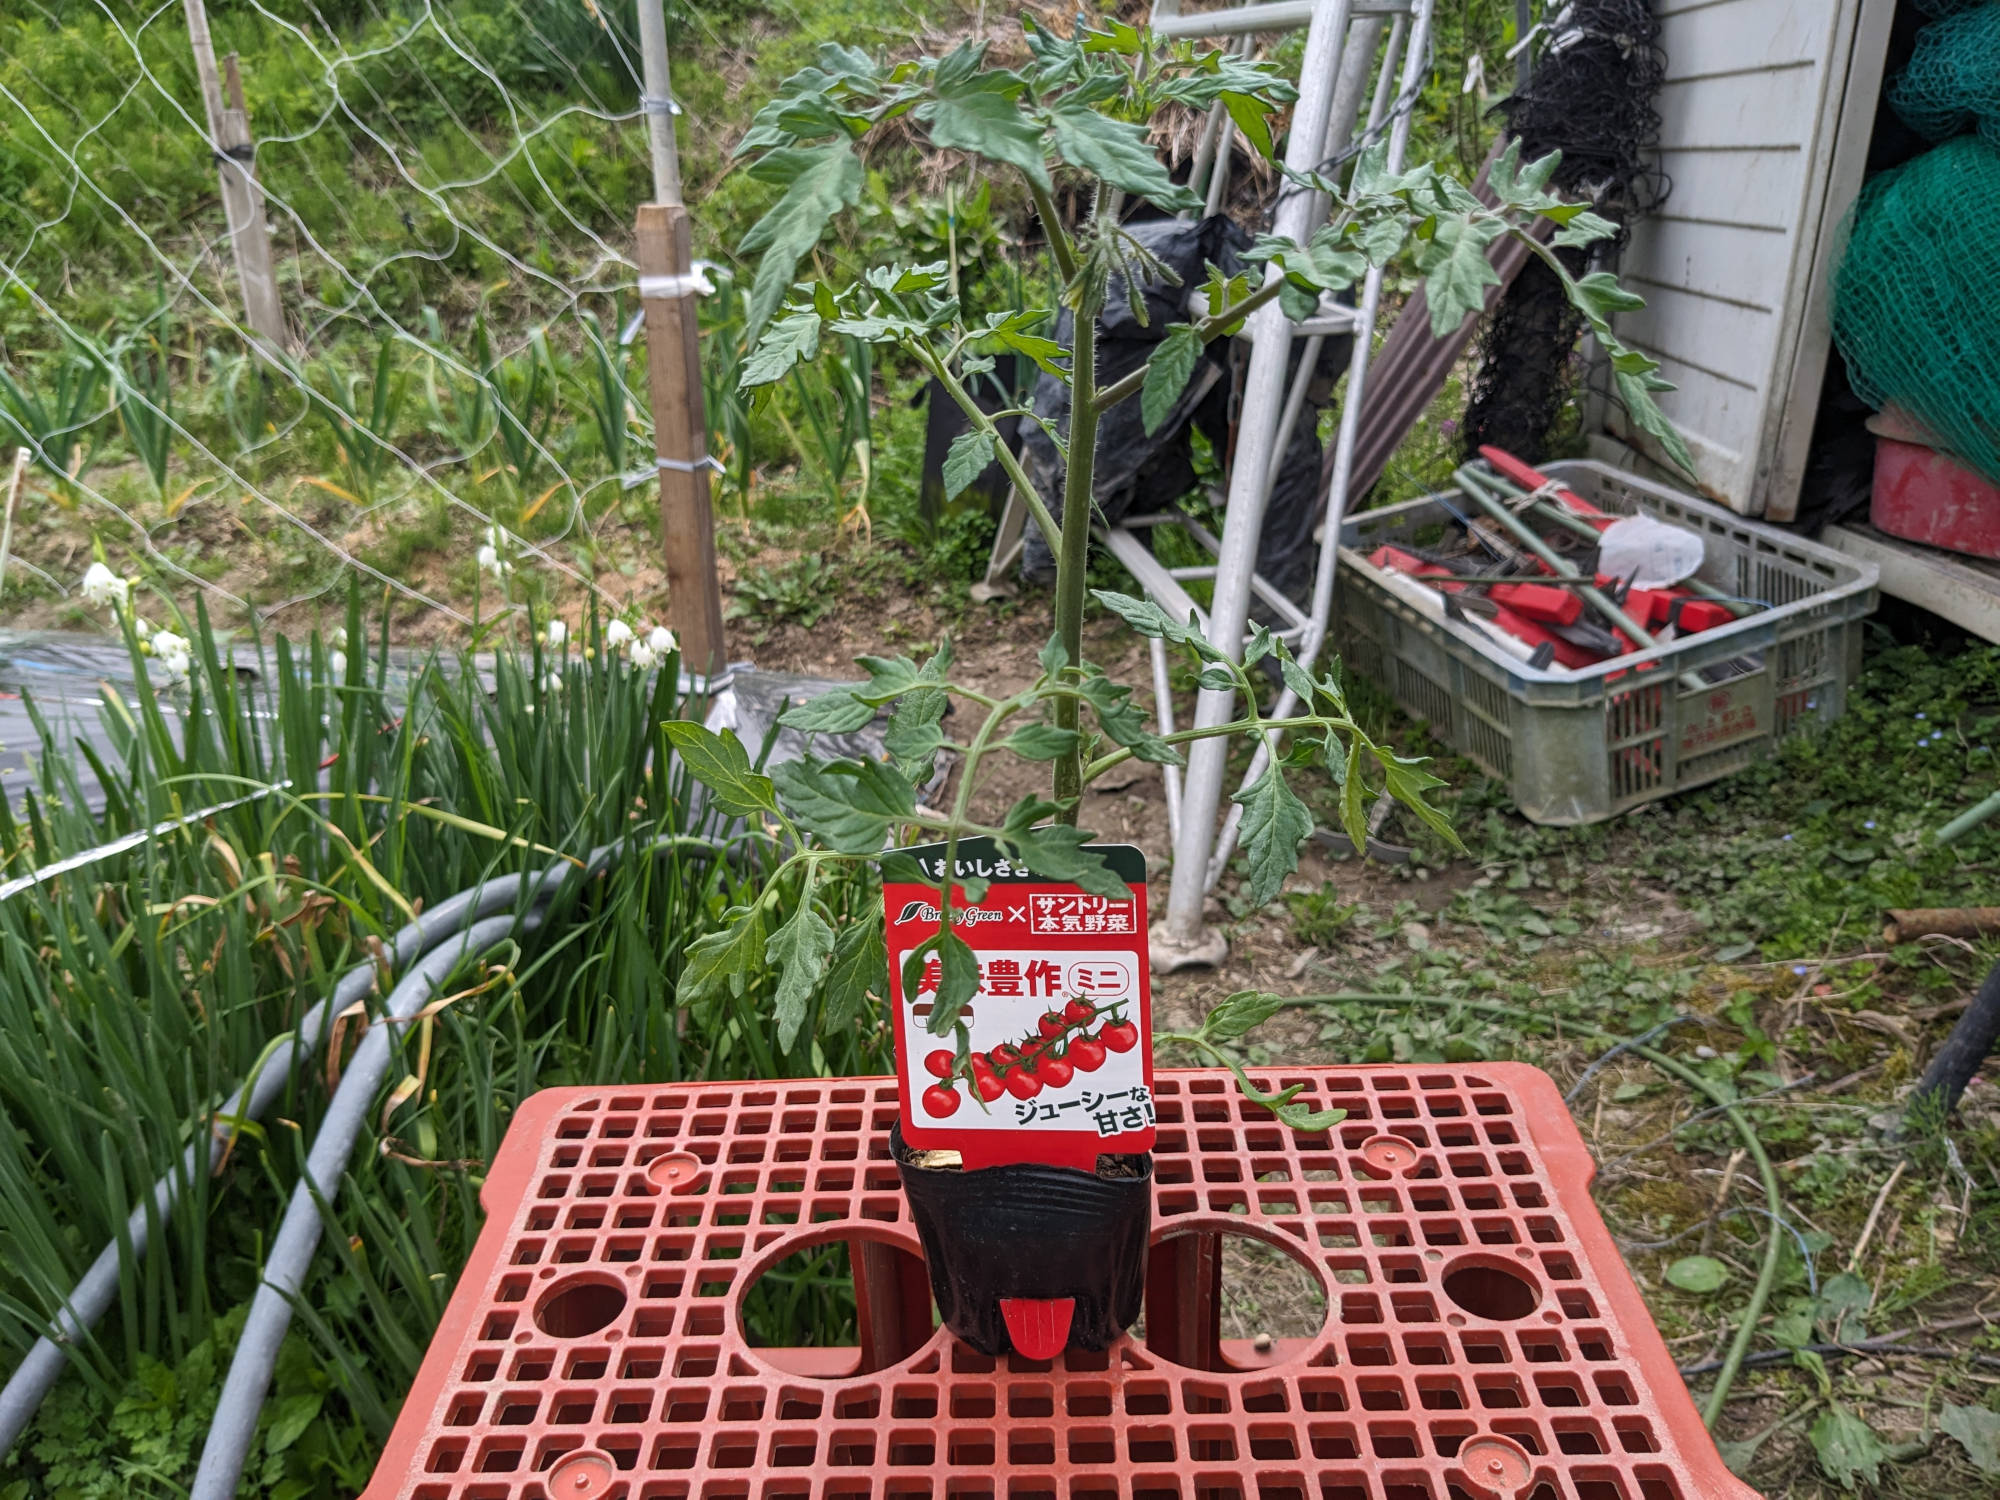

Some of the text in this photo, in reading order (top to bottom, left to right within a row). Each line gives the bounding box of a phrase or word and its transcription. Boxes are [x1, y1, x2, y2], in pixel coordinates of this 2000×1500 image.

[966, 907, 1003, 926] Green
[1037, 897, 1129, 914] サントリー
[1038, 914, 1129, 932] 本気野菜
[916, 958, 1121, 997] 美豊作 ミニ
[1015, 1086, 1150, 1125] ジューシーな
[1092, 1103, 1156, 1135] 甘さ!
